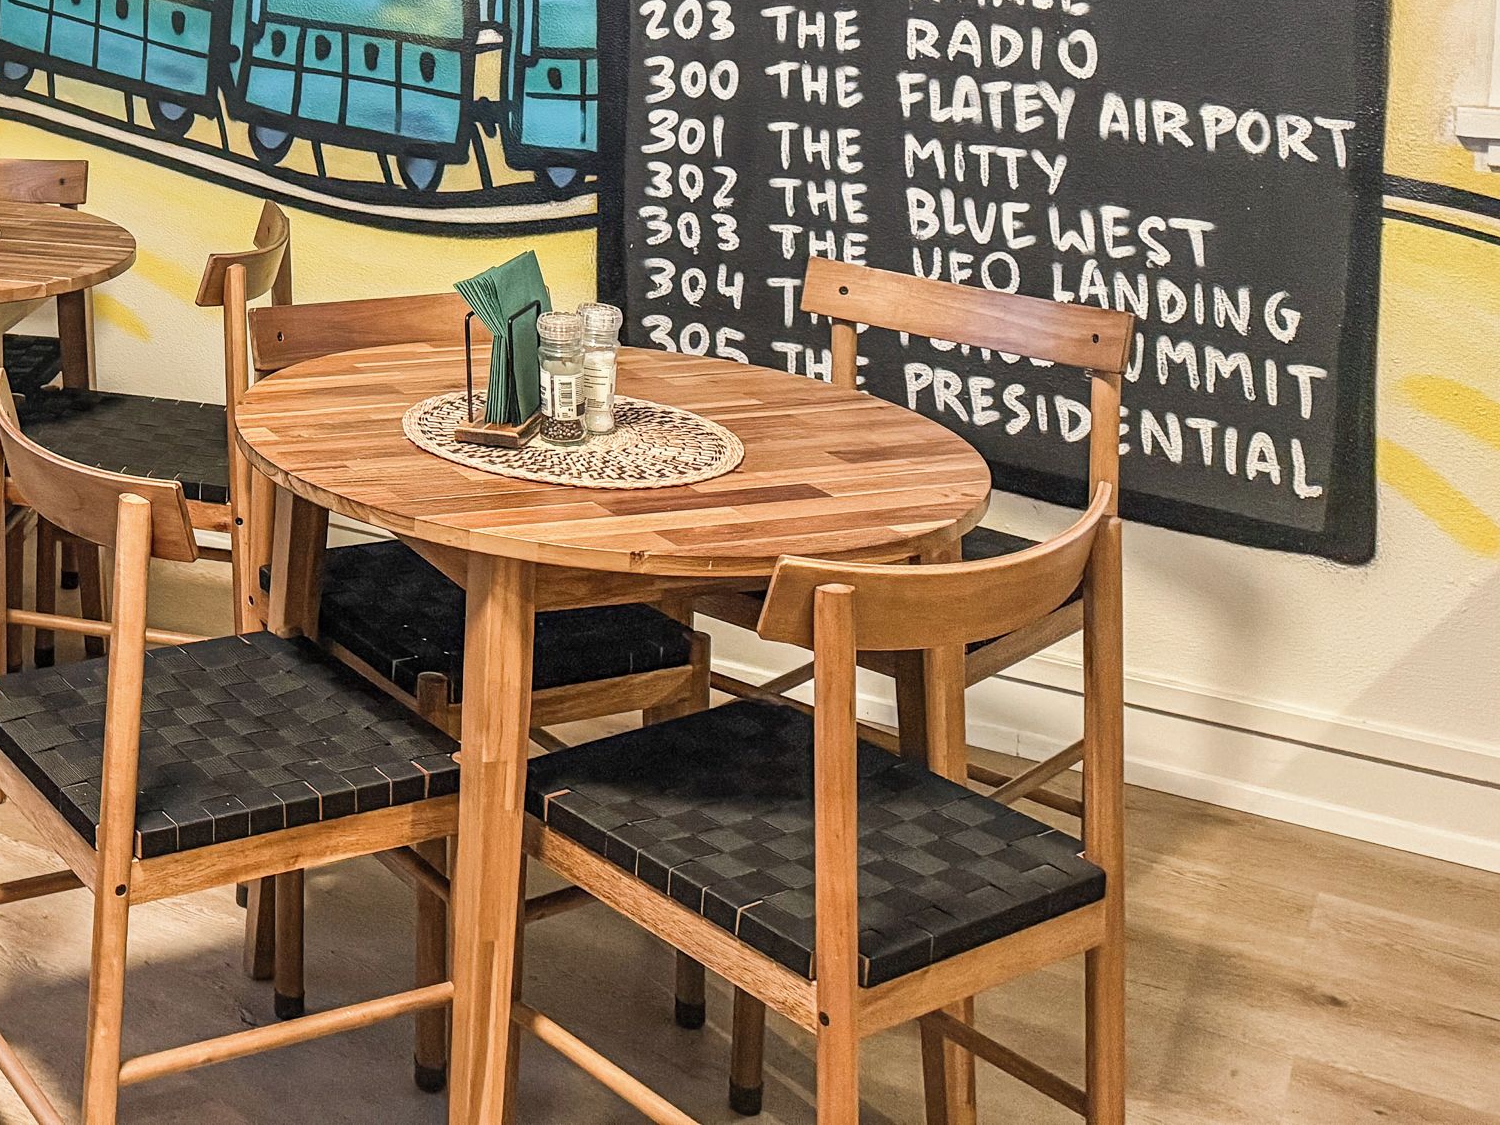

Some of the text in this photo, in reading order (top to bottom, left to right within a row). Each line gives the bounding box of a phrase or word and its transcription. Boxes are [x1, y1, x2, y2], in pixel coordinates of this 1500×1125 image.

[760, 5, 861, 54] THE
[906, 18, 1098, 80] RADIO
[640, 108, 1068, 196] 301 THE MITTY
[643, 55, 1356, 169] 300 THE FLATEY AIRPORT
[644, 161, 1215, 269] 302 THE BLUE WEST
[638, 205, 1301, 344] 303 THE UFO LANDING
[642, 314, 748, 364] 305
[644, 257, 744, 310] 304
[1084, 331, 1328, 420] UMMIT
